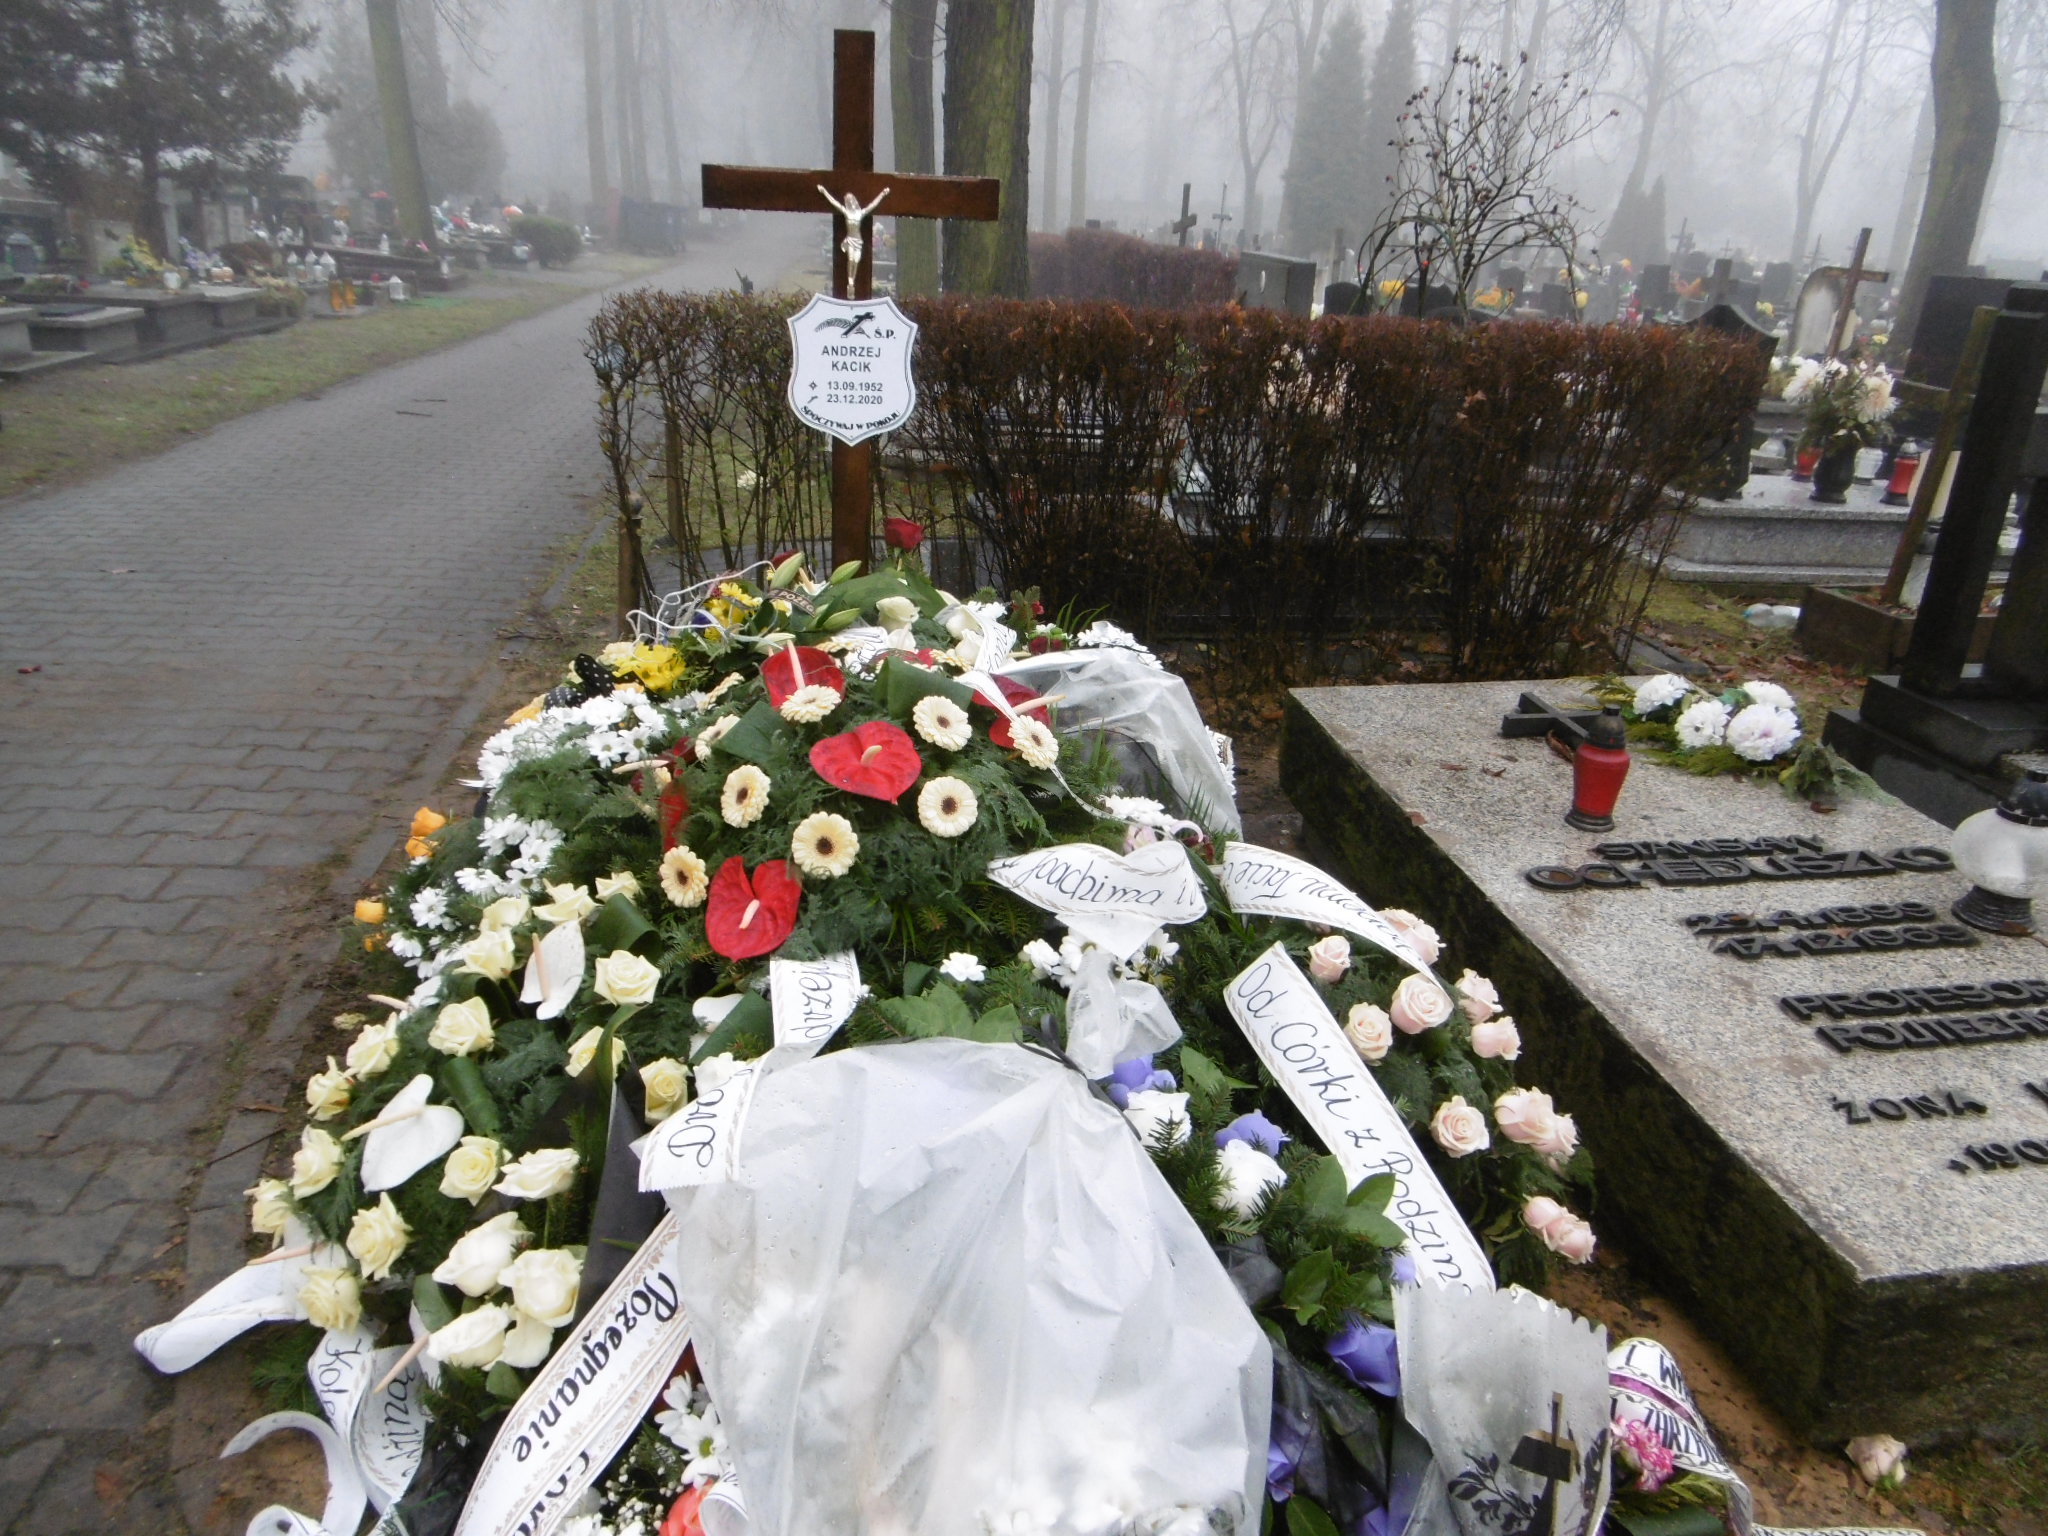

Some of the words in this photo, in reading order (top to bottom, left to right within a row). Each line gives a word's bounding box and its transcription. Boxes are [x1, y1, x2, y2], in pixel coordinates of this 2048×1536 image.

[821, 345, 881, 358] ANDRZEJ
[831, 360, 872, 373] KACIK
[827, 381, 883, 392] 13.09.1952
[826, 394, 883, 405] 23.12.2020
[801, 405, 854, 430] SPOCZYWAJ
[1237, 962, 1289, 1019] Od
[1270, 1022, 1360, 1121] Córki
[1362, 1151, 1472, 1294] Rodzin
